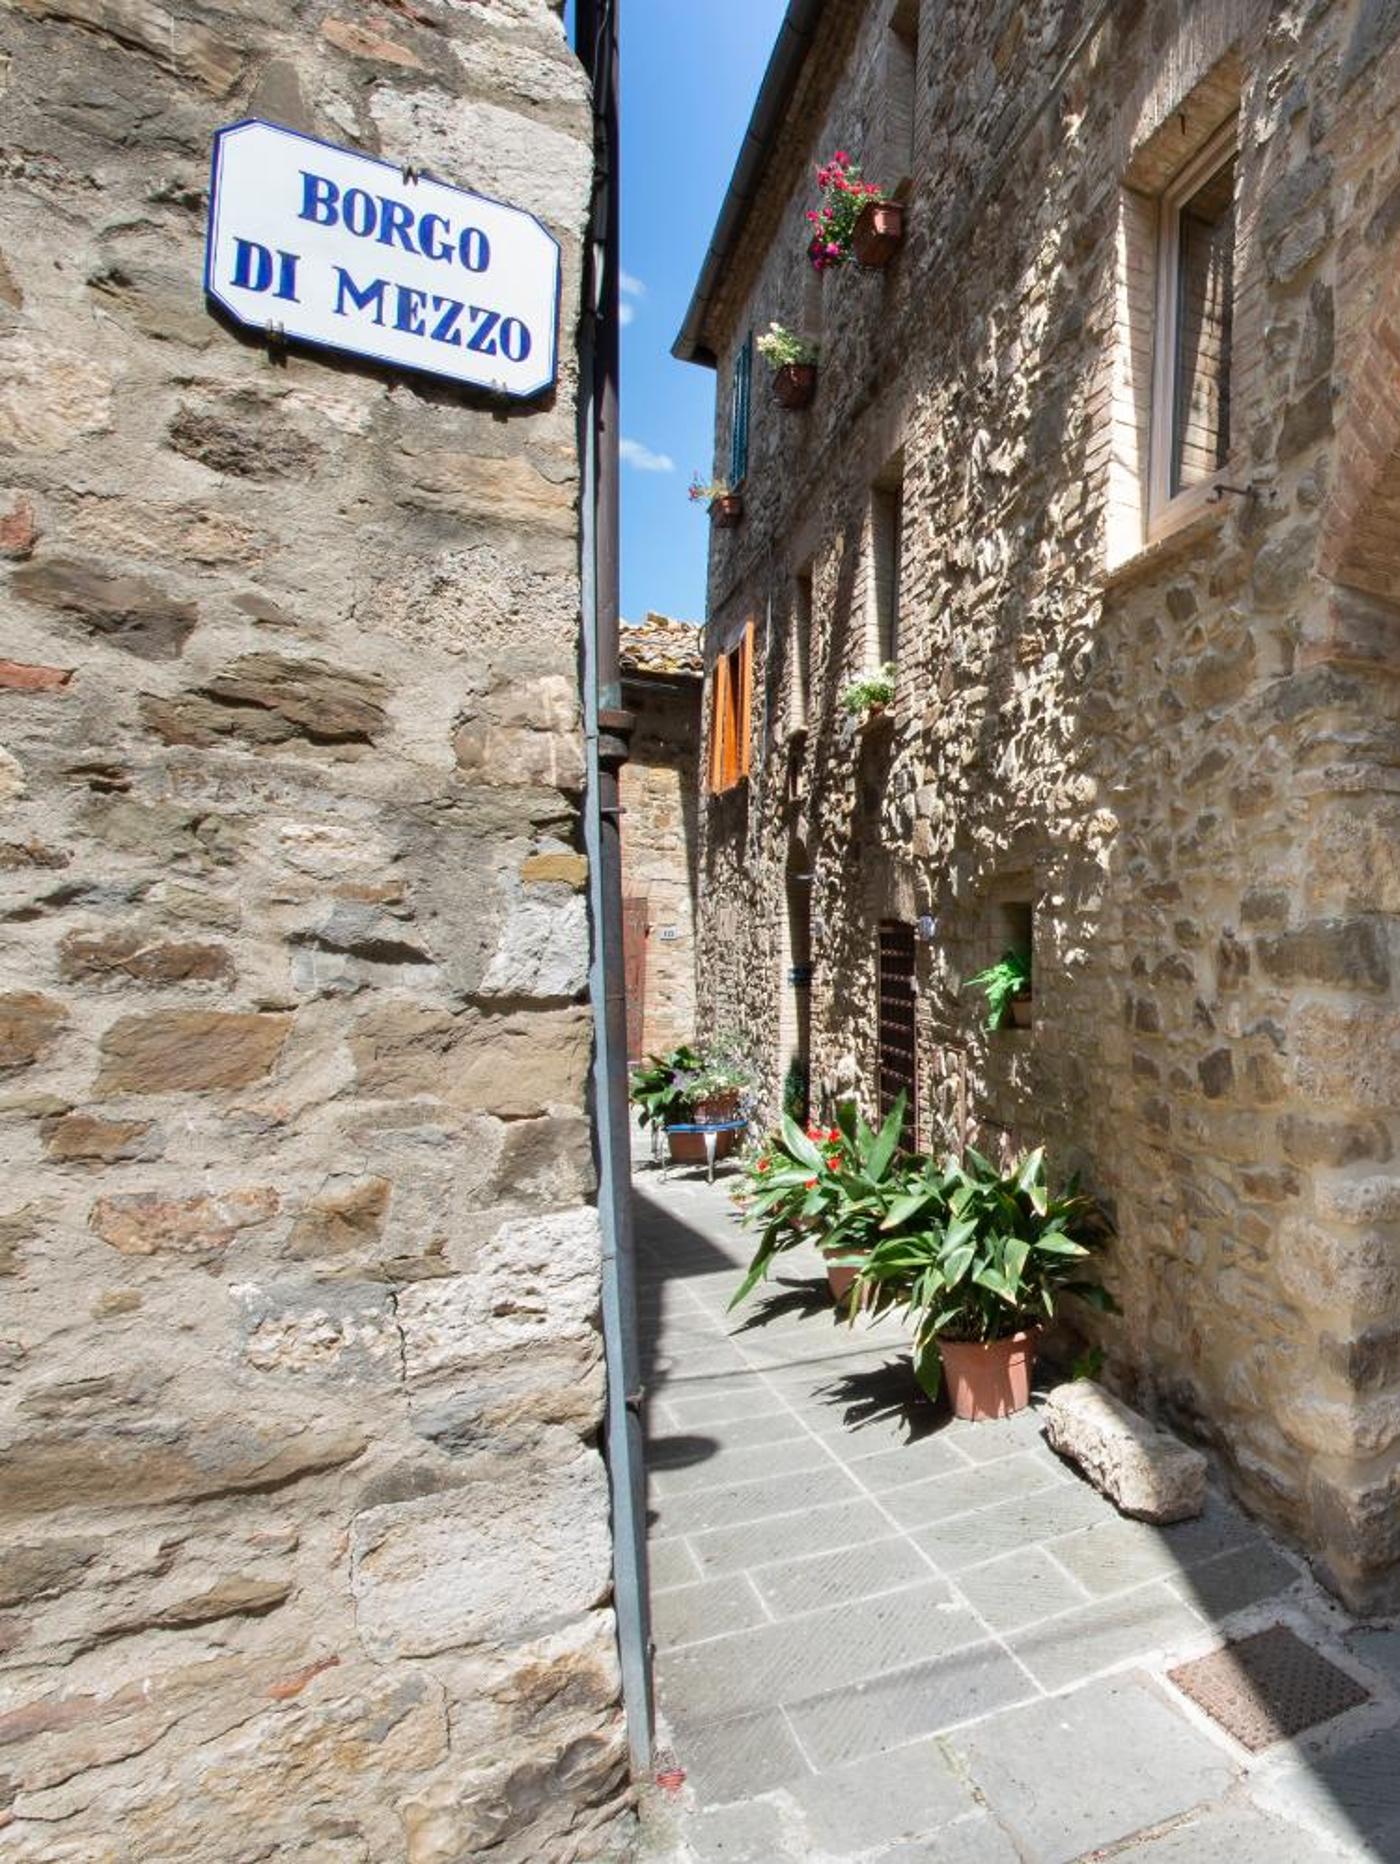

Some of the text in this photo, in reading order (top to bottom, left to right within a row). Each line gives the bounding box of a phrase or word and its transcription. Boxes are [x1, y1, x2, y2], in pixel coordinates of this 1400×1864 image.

[298, 171, 490, 273] BORGO
[230, 237, 531, 363] DI MEZZO
